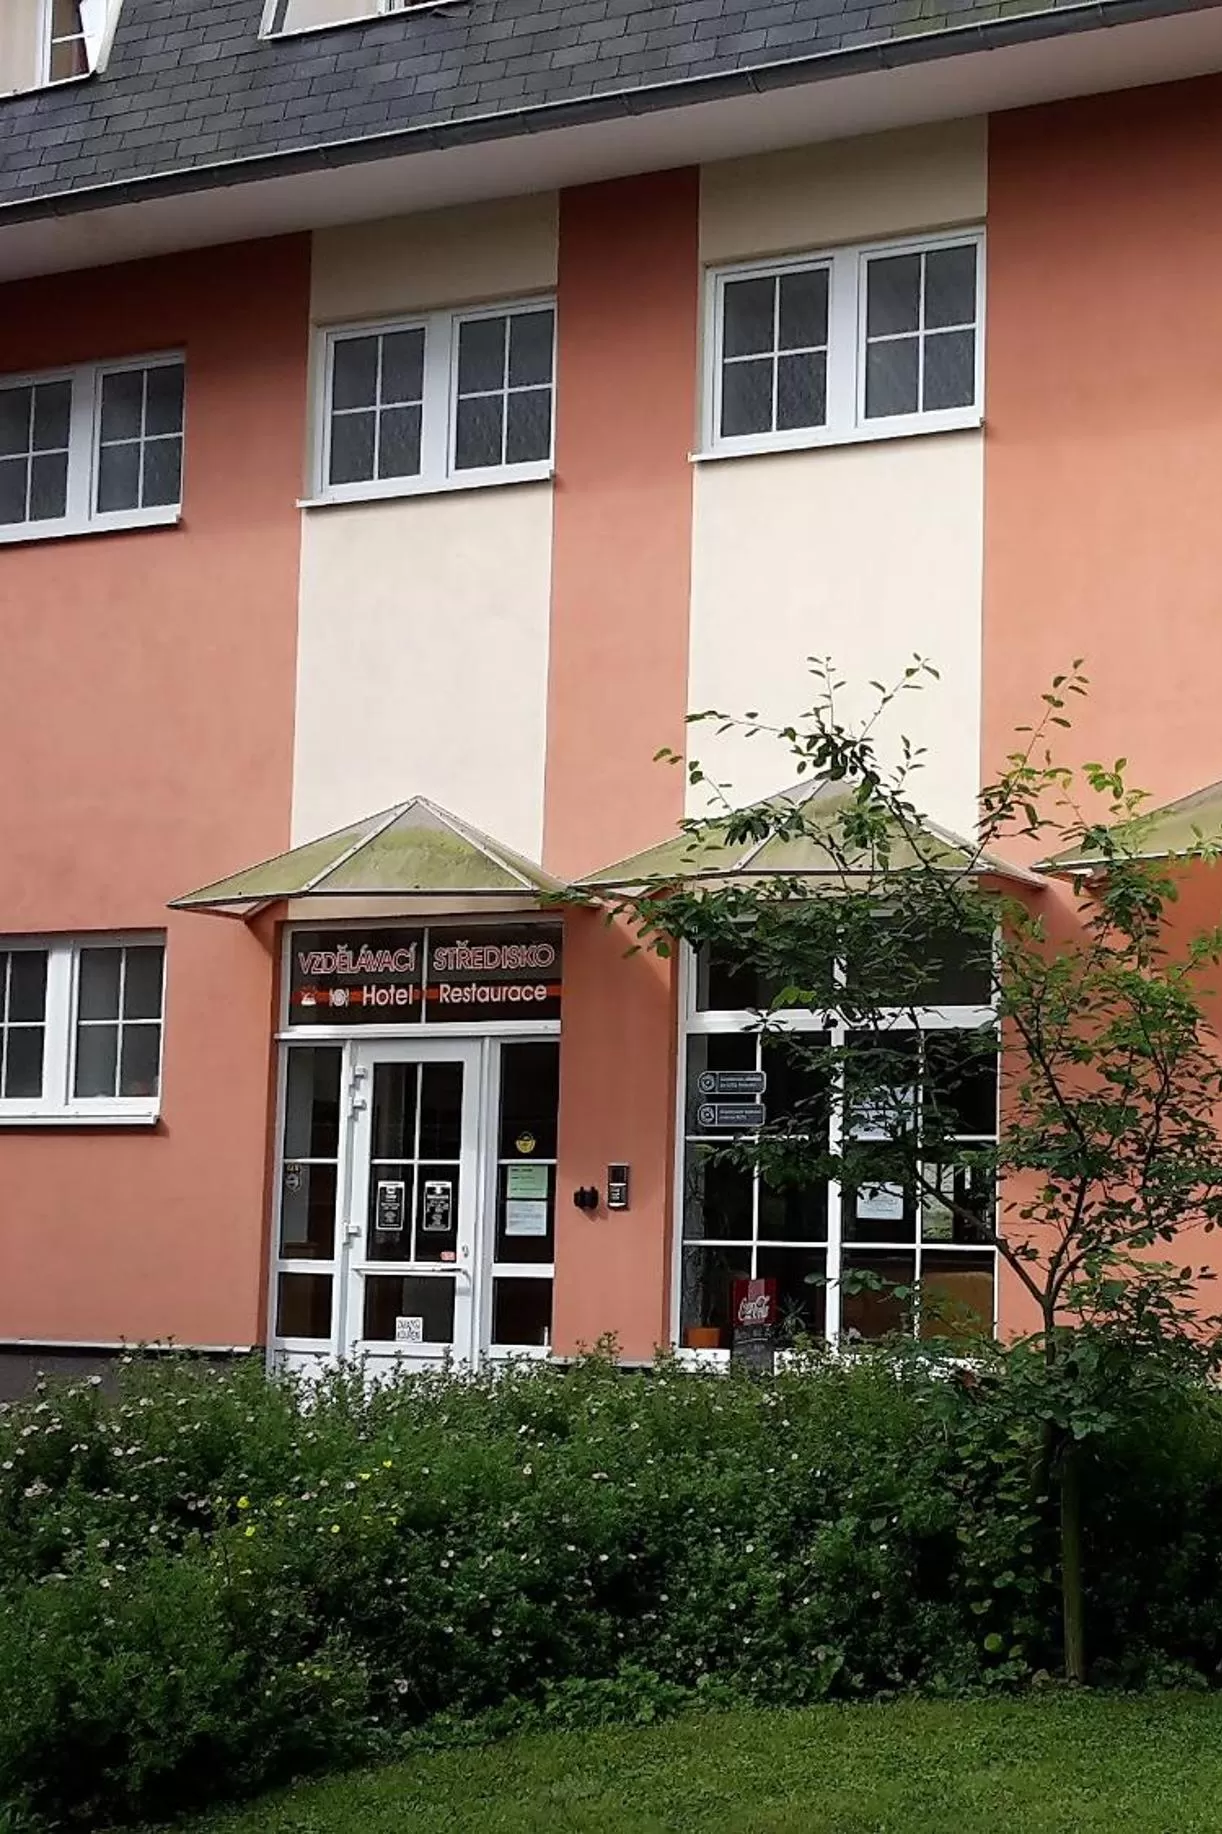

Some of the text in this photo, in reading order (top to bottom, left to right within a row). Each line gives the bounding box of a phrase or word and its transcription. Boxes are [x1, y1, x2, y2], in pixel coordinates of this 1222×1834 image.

[298, 940, 556, 975] VZDĚLÁVACÍ STŘEDISKO
[362, 983, 548, 1006] Hotel Restaurace
